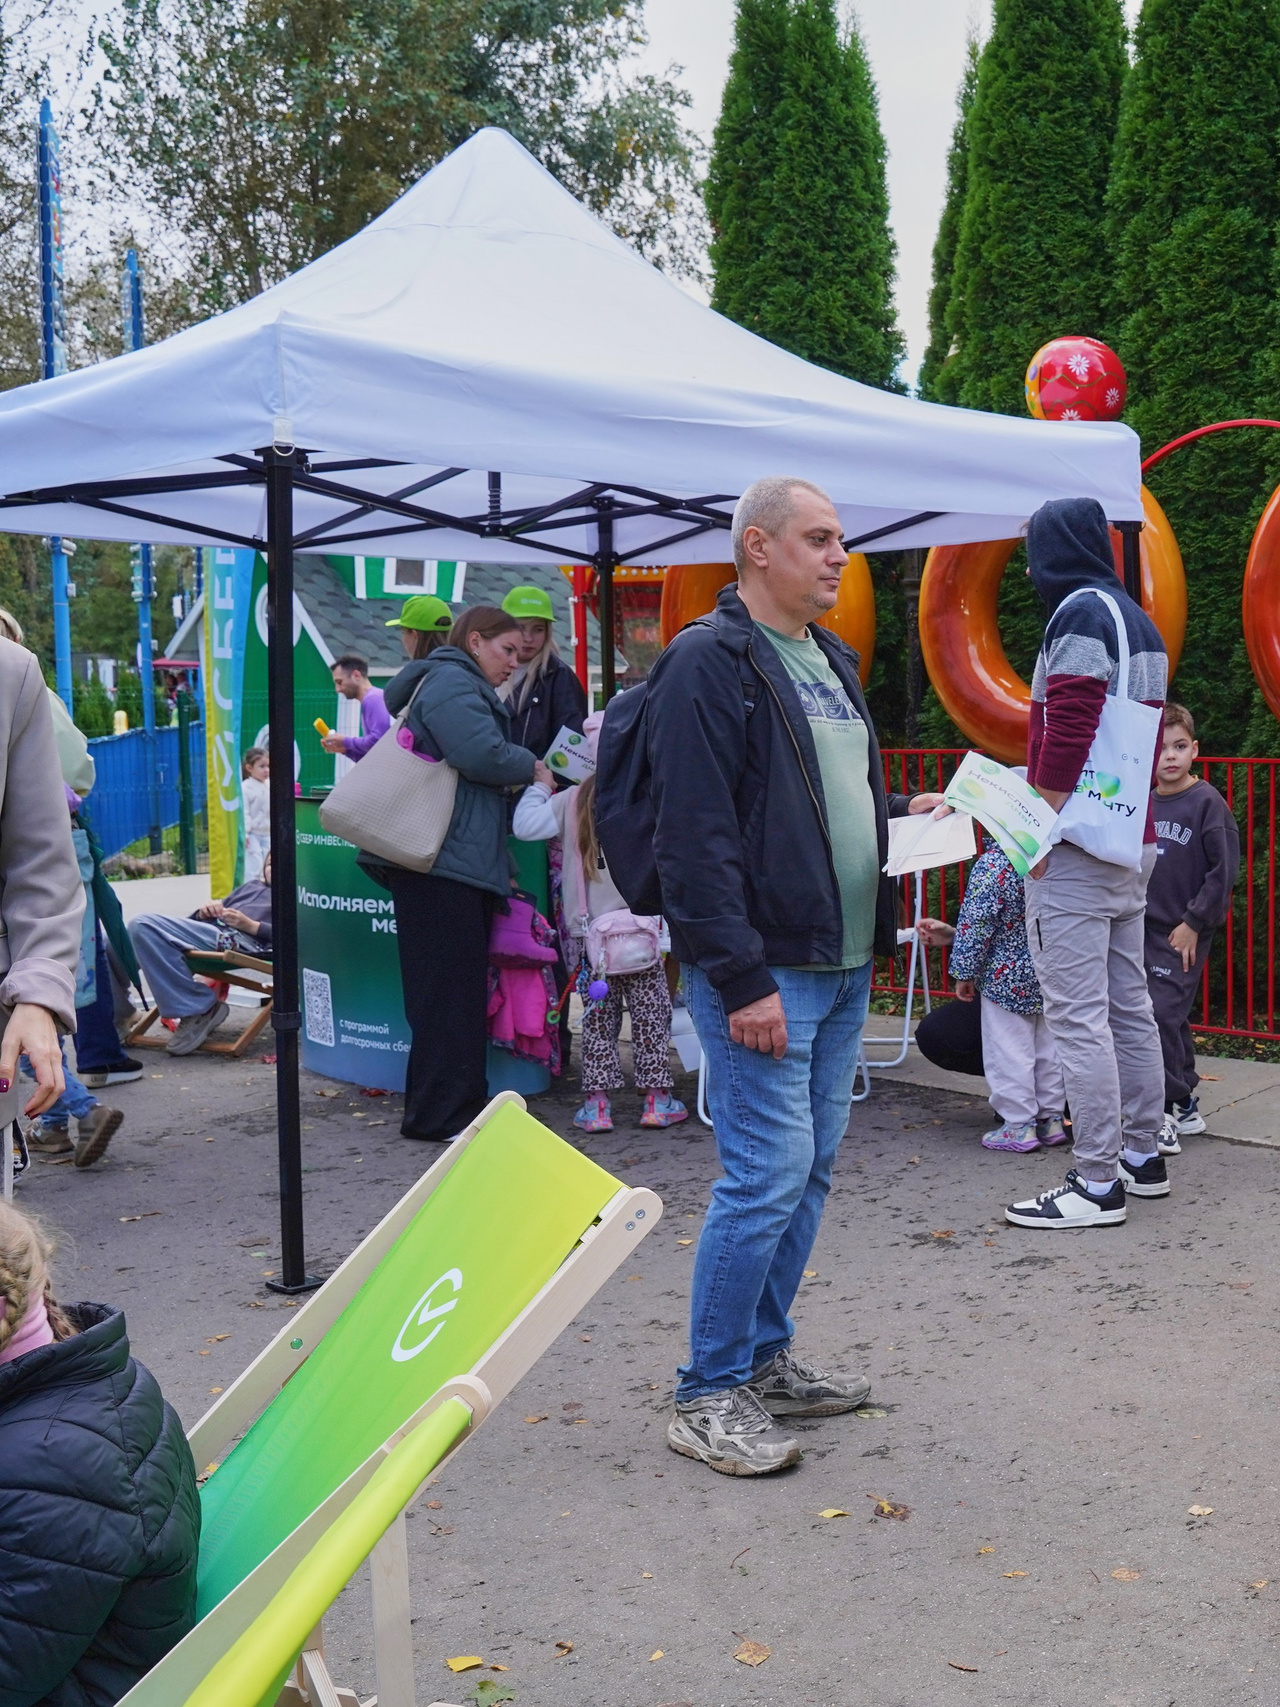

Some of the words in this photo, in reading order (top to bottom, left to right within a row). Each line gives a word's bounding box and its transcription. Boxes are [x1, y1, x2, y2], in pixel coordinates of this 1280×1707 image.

[968, 770, 1041, 827] Некислого
[1154, 820, 1193, 846] VARD
[297, 885, 395, 914] Исполняем
[339, 1019, 344, 1027] с
[344, 1020, 389, 1034] программой
[340, 1034, 391, 1050] долгосрочных
